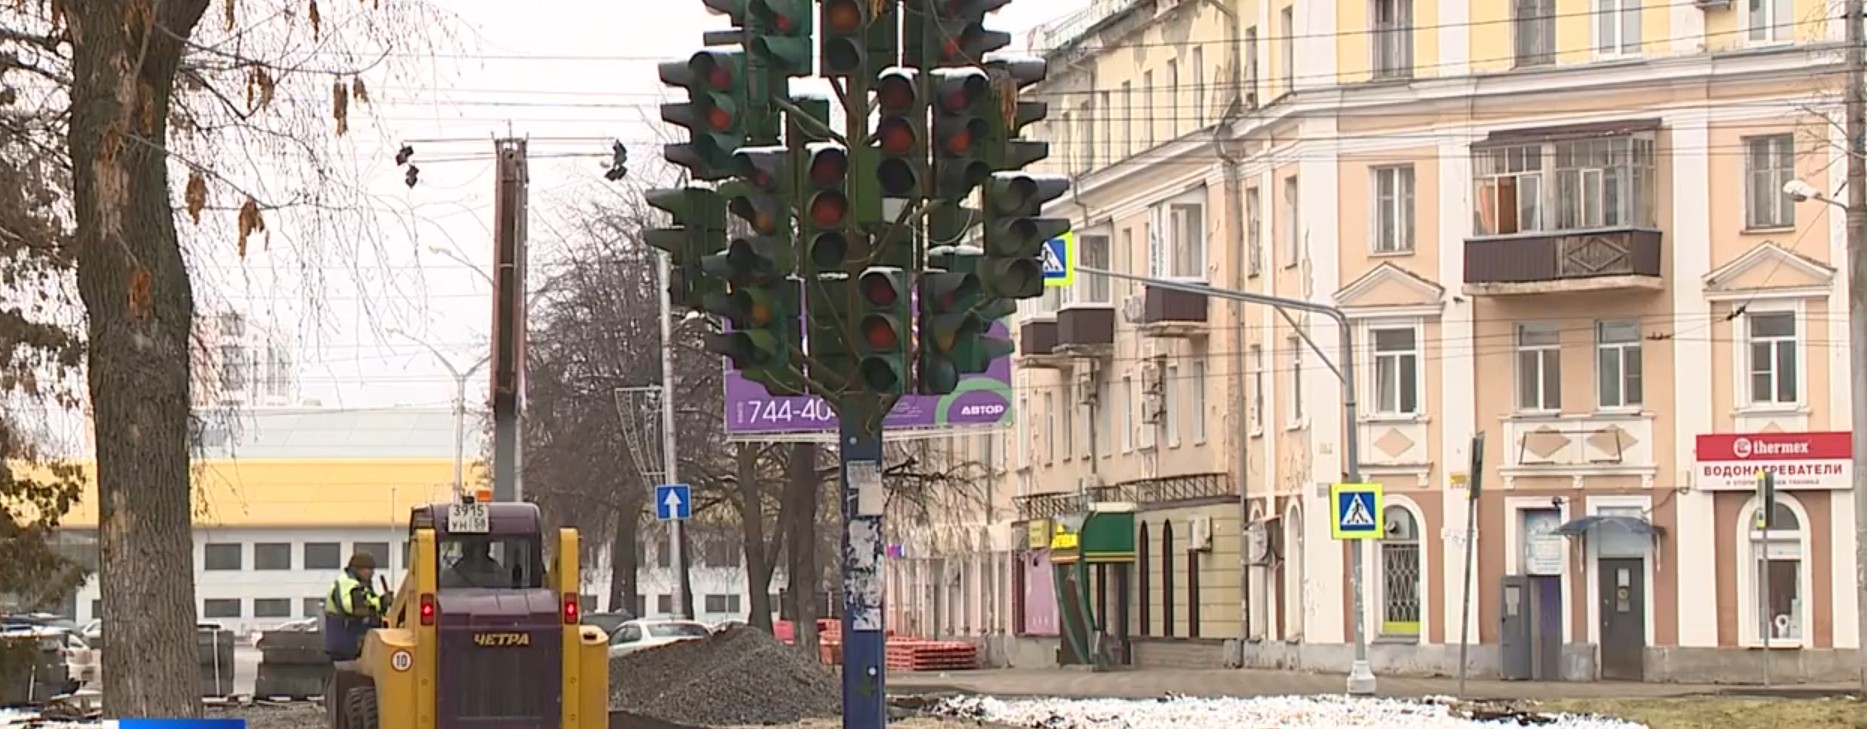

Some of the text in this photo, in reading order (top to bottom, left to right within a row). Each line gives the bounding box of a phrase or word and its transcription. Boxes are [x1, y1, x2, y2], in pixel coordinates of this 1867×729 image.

[748, 398, 837, 423] 744-40
[960, 404, 1004, 416] АВТОР
[1753, 440, 1809, 455] thermex
[1703, 463, 1843, 478] ВОДОНАГРЕВАТЕЛИ
[453, 504, 485, 517] 3915
[473, 633, 530, 645] ЧЕТРА
[396, 655, 407, 667] 10
